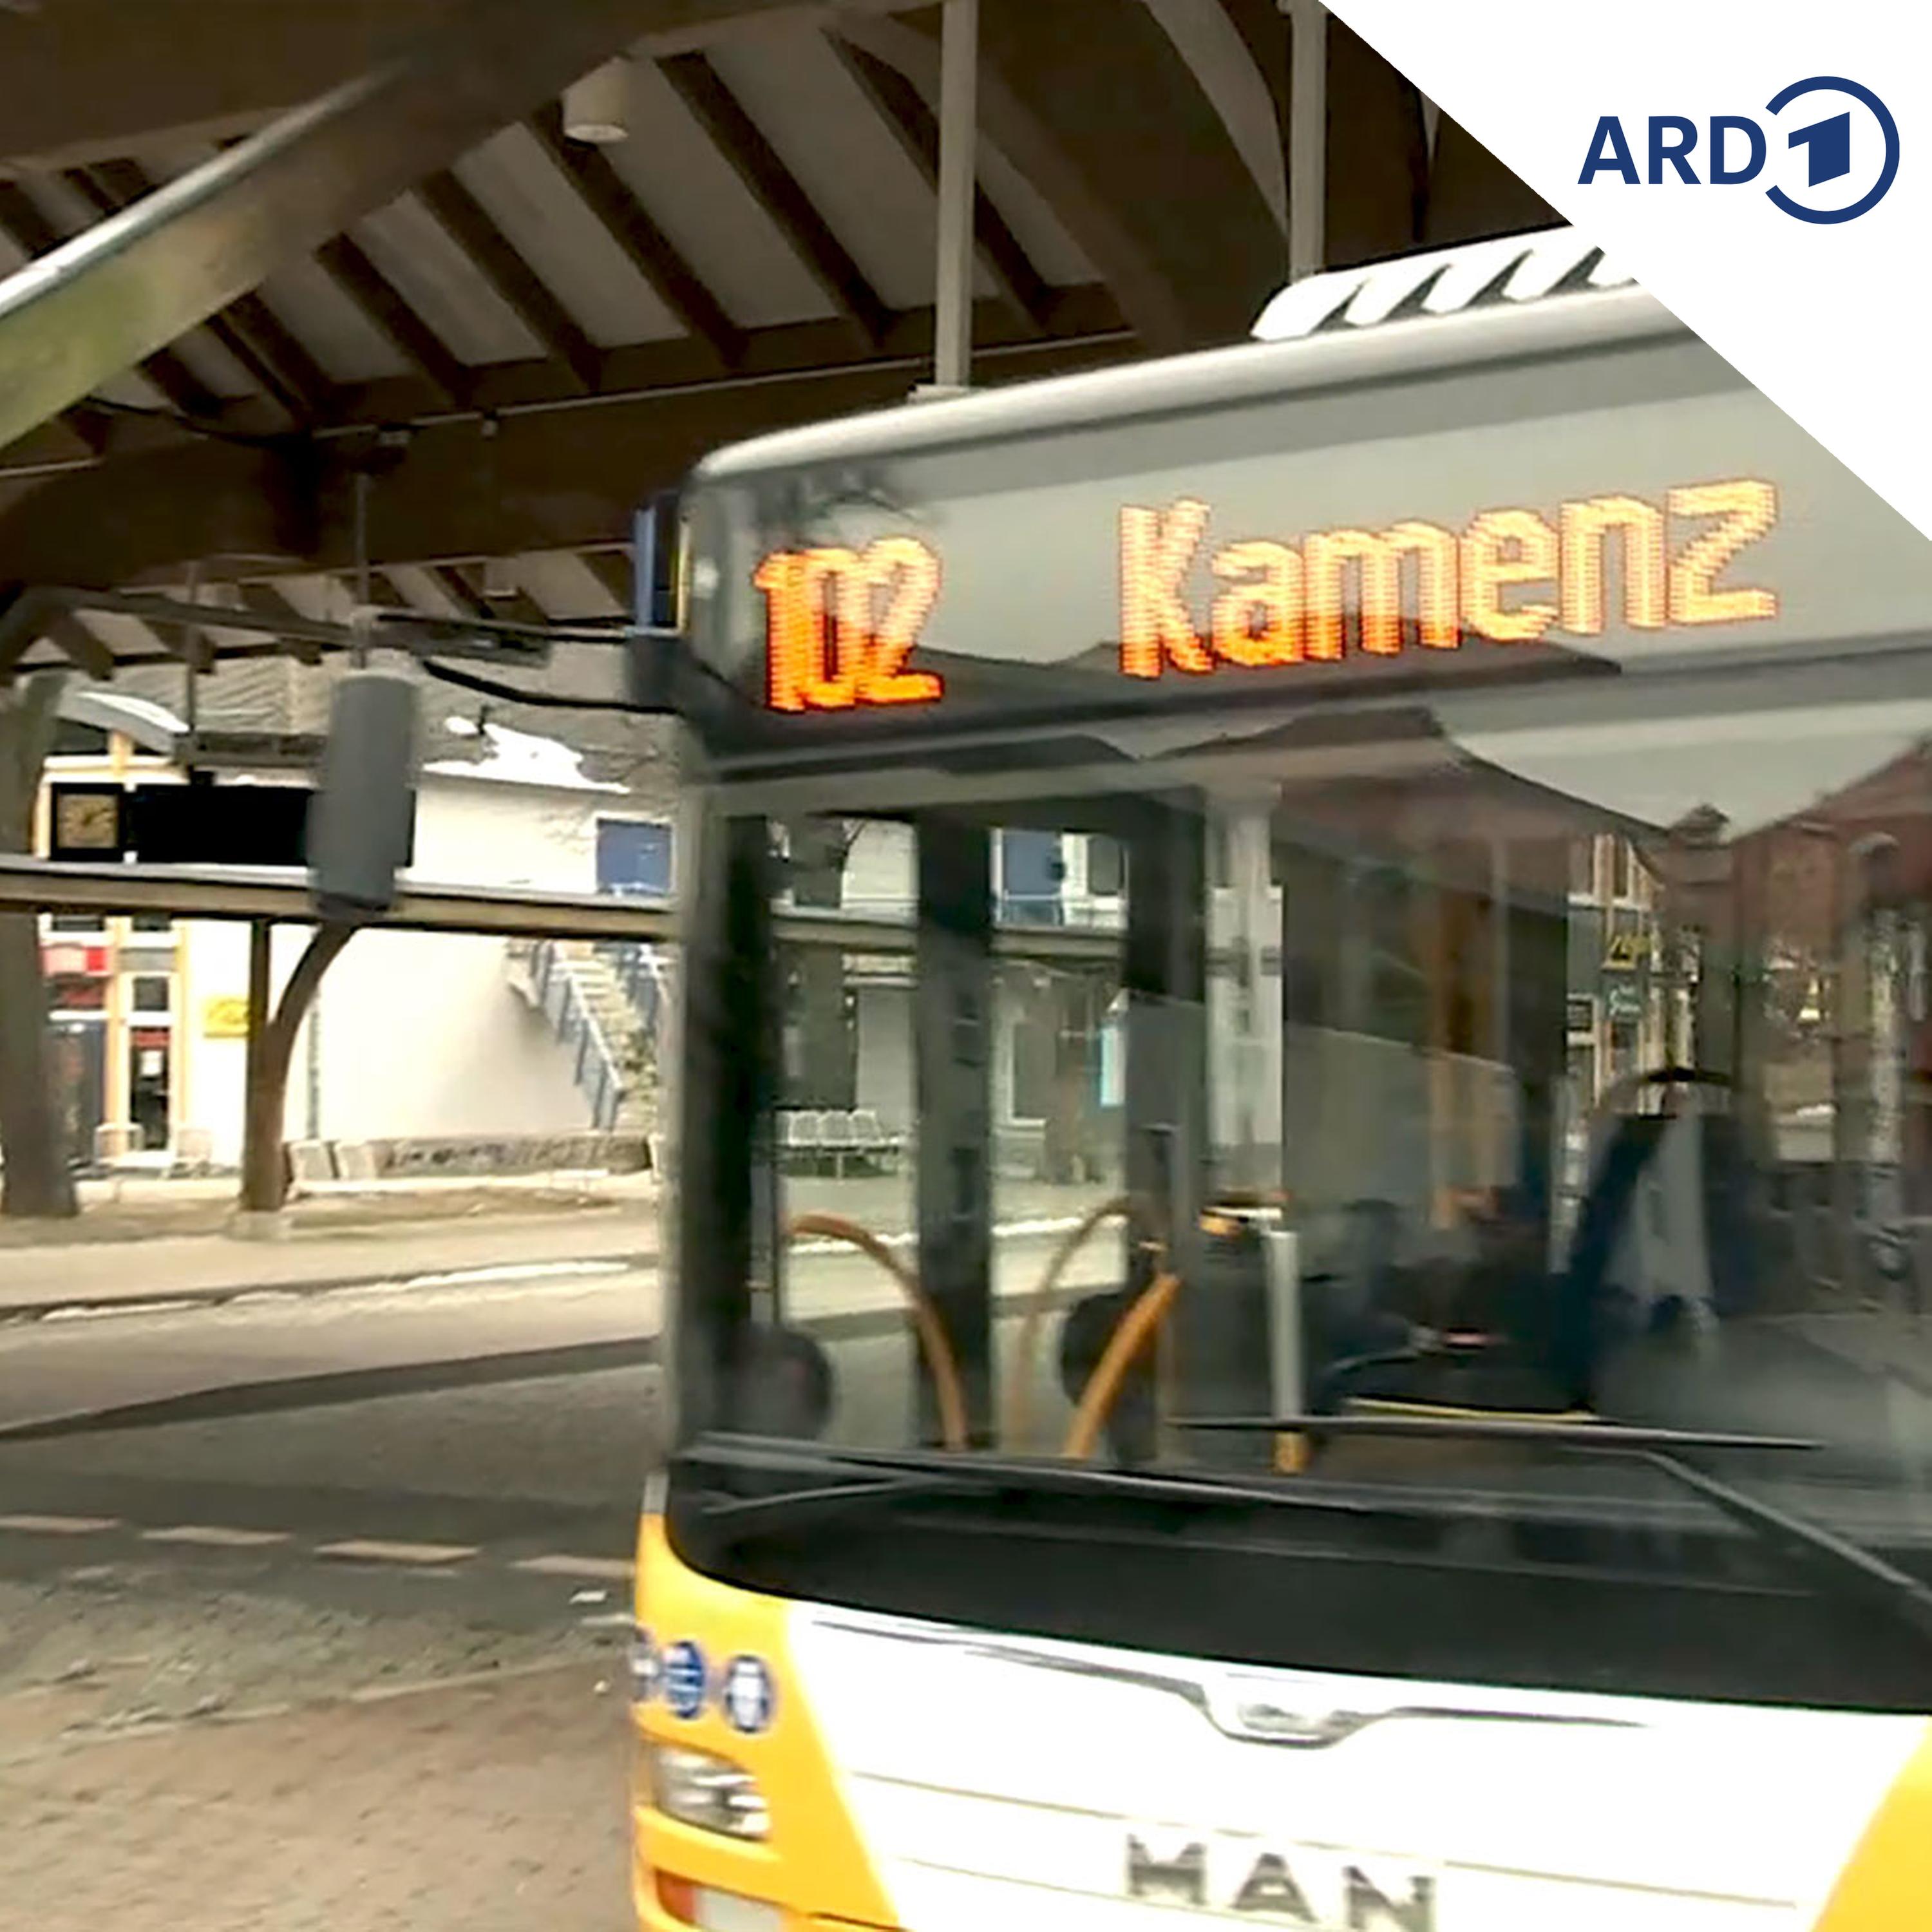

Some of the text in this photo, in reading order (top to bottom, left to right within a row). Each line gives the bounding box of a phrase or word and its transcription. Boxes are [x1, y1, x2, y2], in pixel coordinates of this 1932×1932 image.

[752, 479, 1777, 712] 102 Kamenz
[1126, 1834, 1435, 1932] MAN
